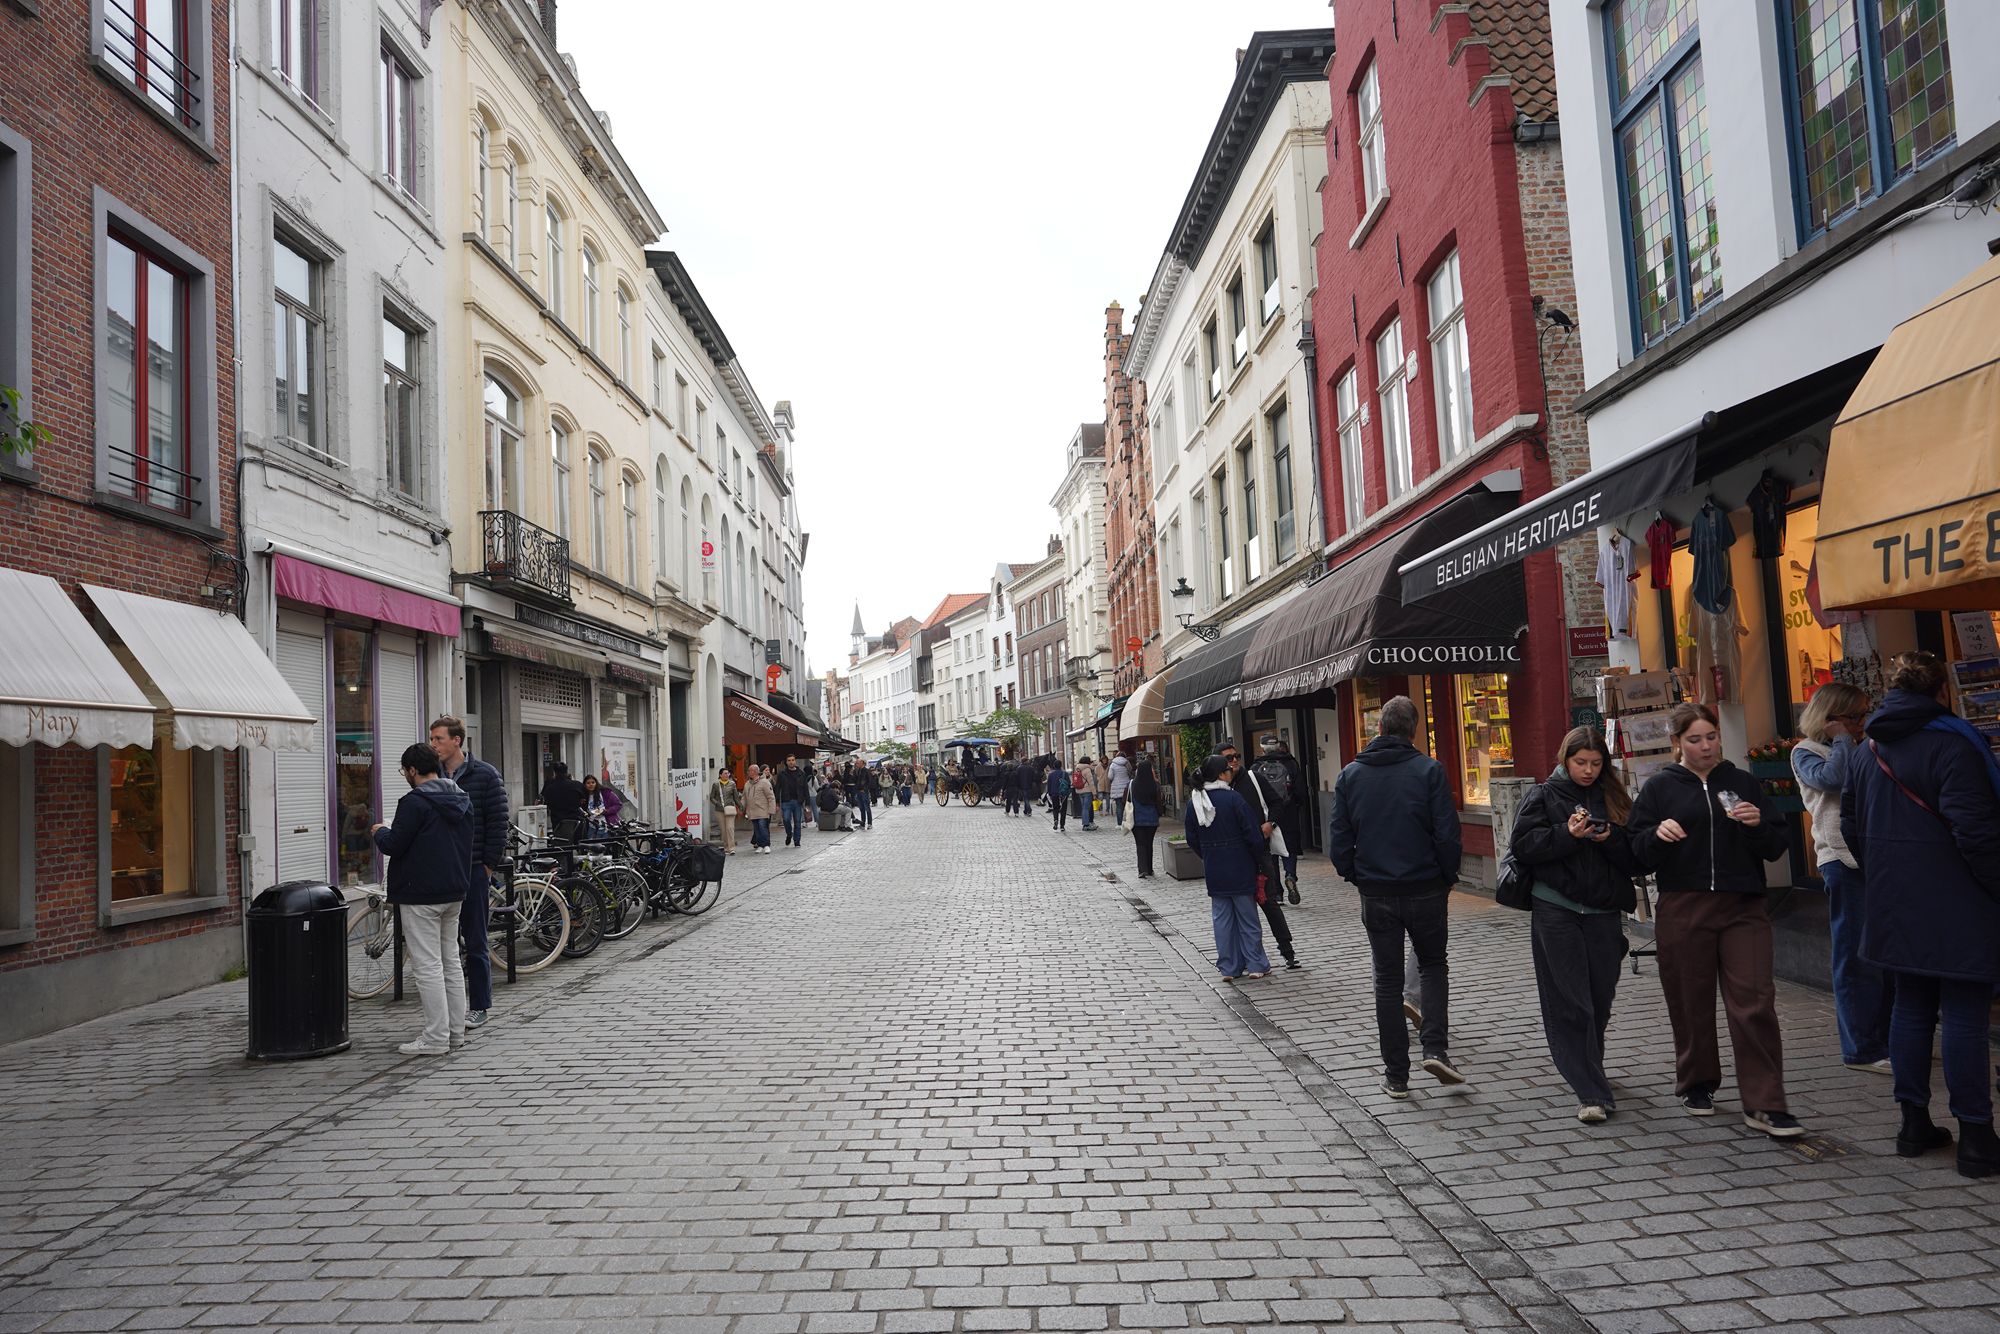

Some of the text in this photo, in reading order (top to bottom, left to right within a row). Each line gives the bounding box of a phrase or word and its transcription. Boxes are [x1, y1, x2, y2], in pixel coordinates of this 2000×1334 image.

[1436, 492, 1602, 586] BELGIAN HERITAGE
[1873, 519, 1965, 584] THE
[1785, 610, 1814, 630] SOU
[1367, 645, 1521, 665] CHOCOHOLIC
[26, 706, 79, 739] Mary
[731, 700, 788, 731] BELGIAN CHOCOLATES
[740, 711, 774, 731] BEST PRICE
[236, 719, 268, 745] Mary
